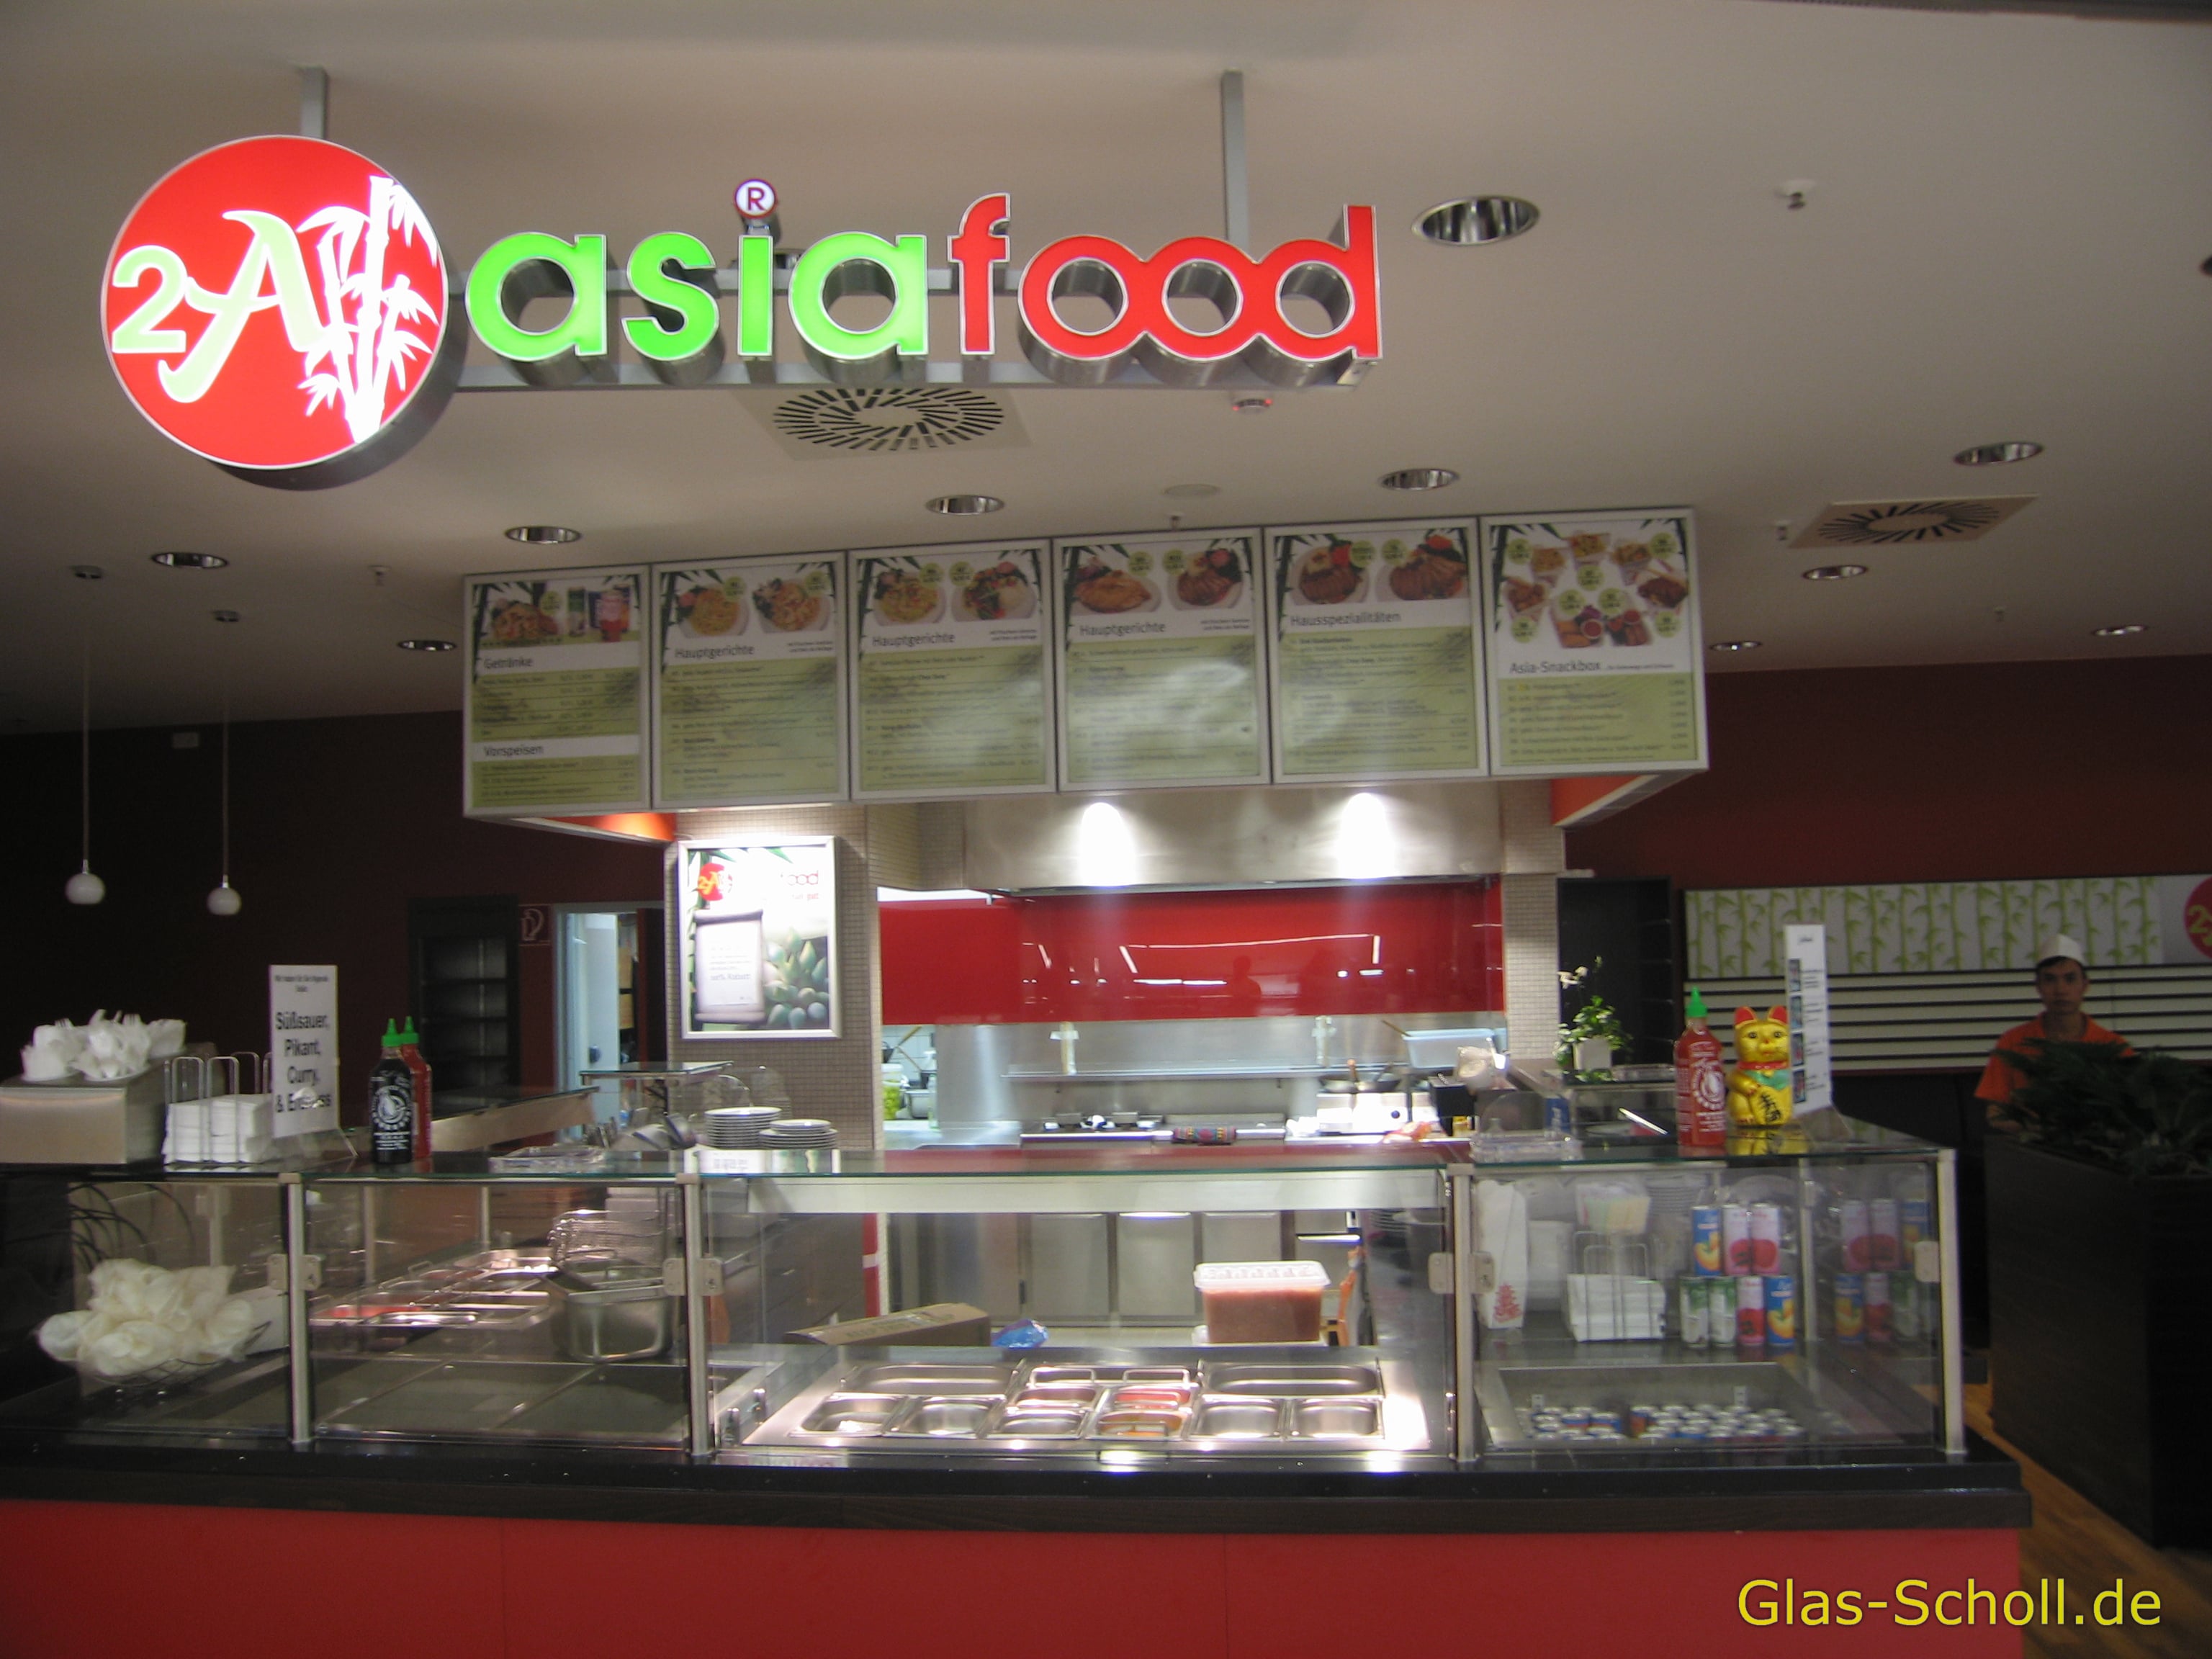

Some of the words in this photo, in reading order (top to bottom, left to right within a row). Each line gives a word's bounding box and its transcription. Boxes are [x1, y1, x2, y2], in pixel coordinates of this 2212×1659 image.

[1080, 621, 1166, 637] Hauptgerichte
[872, 633, 956, 647] Hauptgerichte
[674, 645, 755, 660] Hauptgerichte
[1509, 660, 1601, 675] Asia-Snackbox
